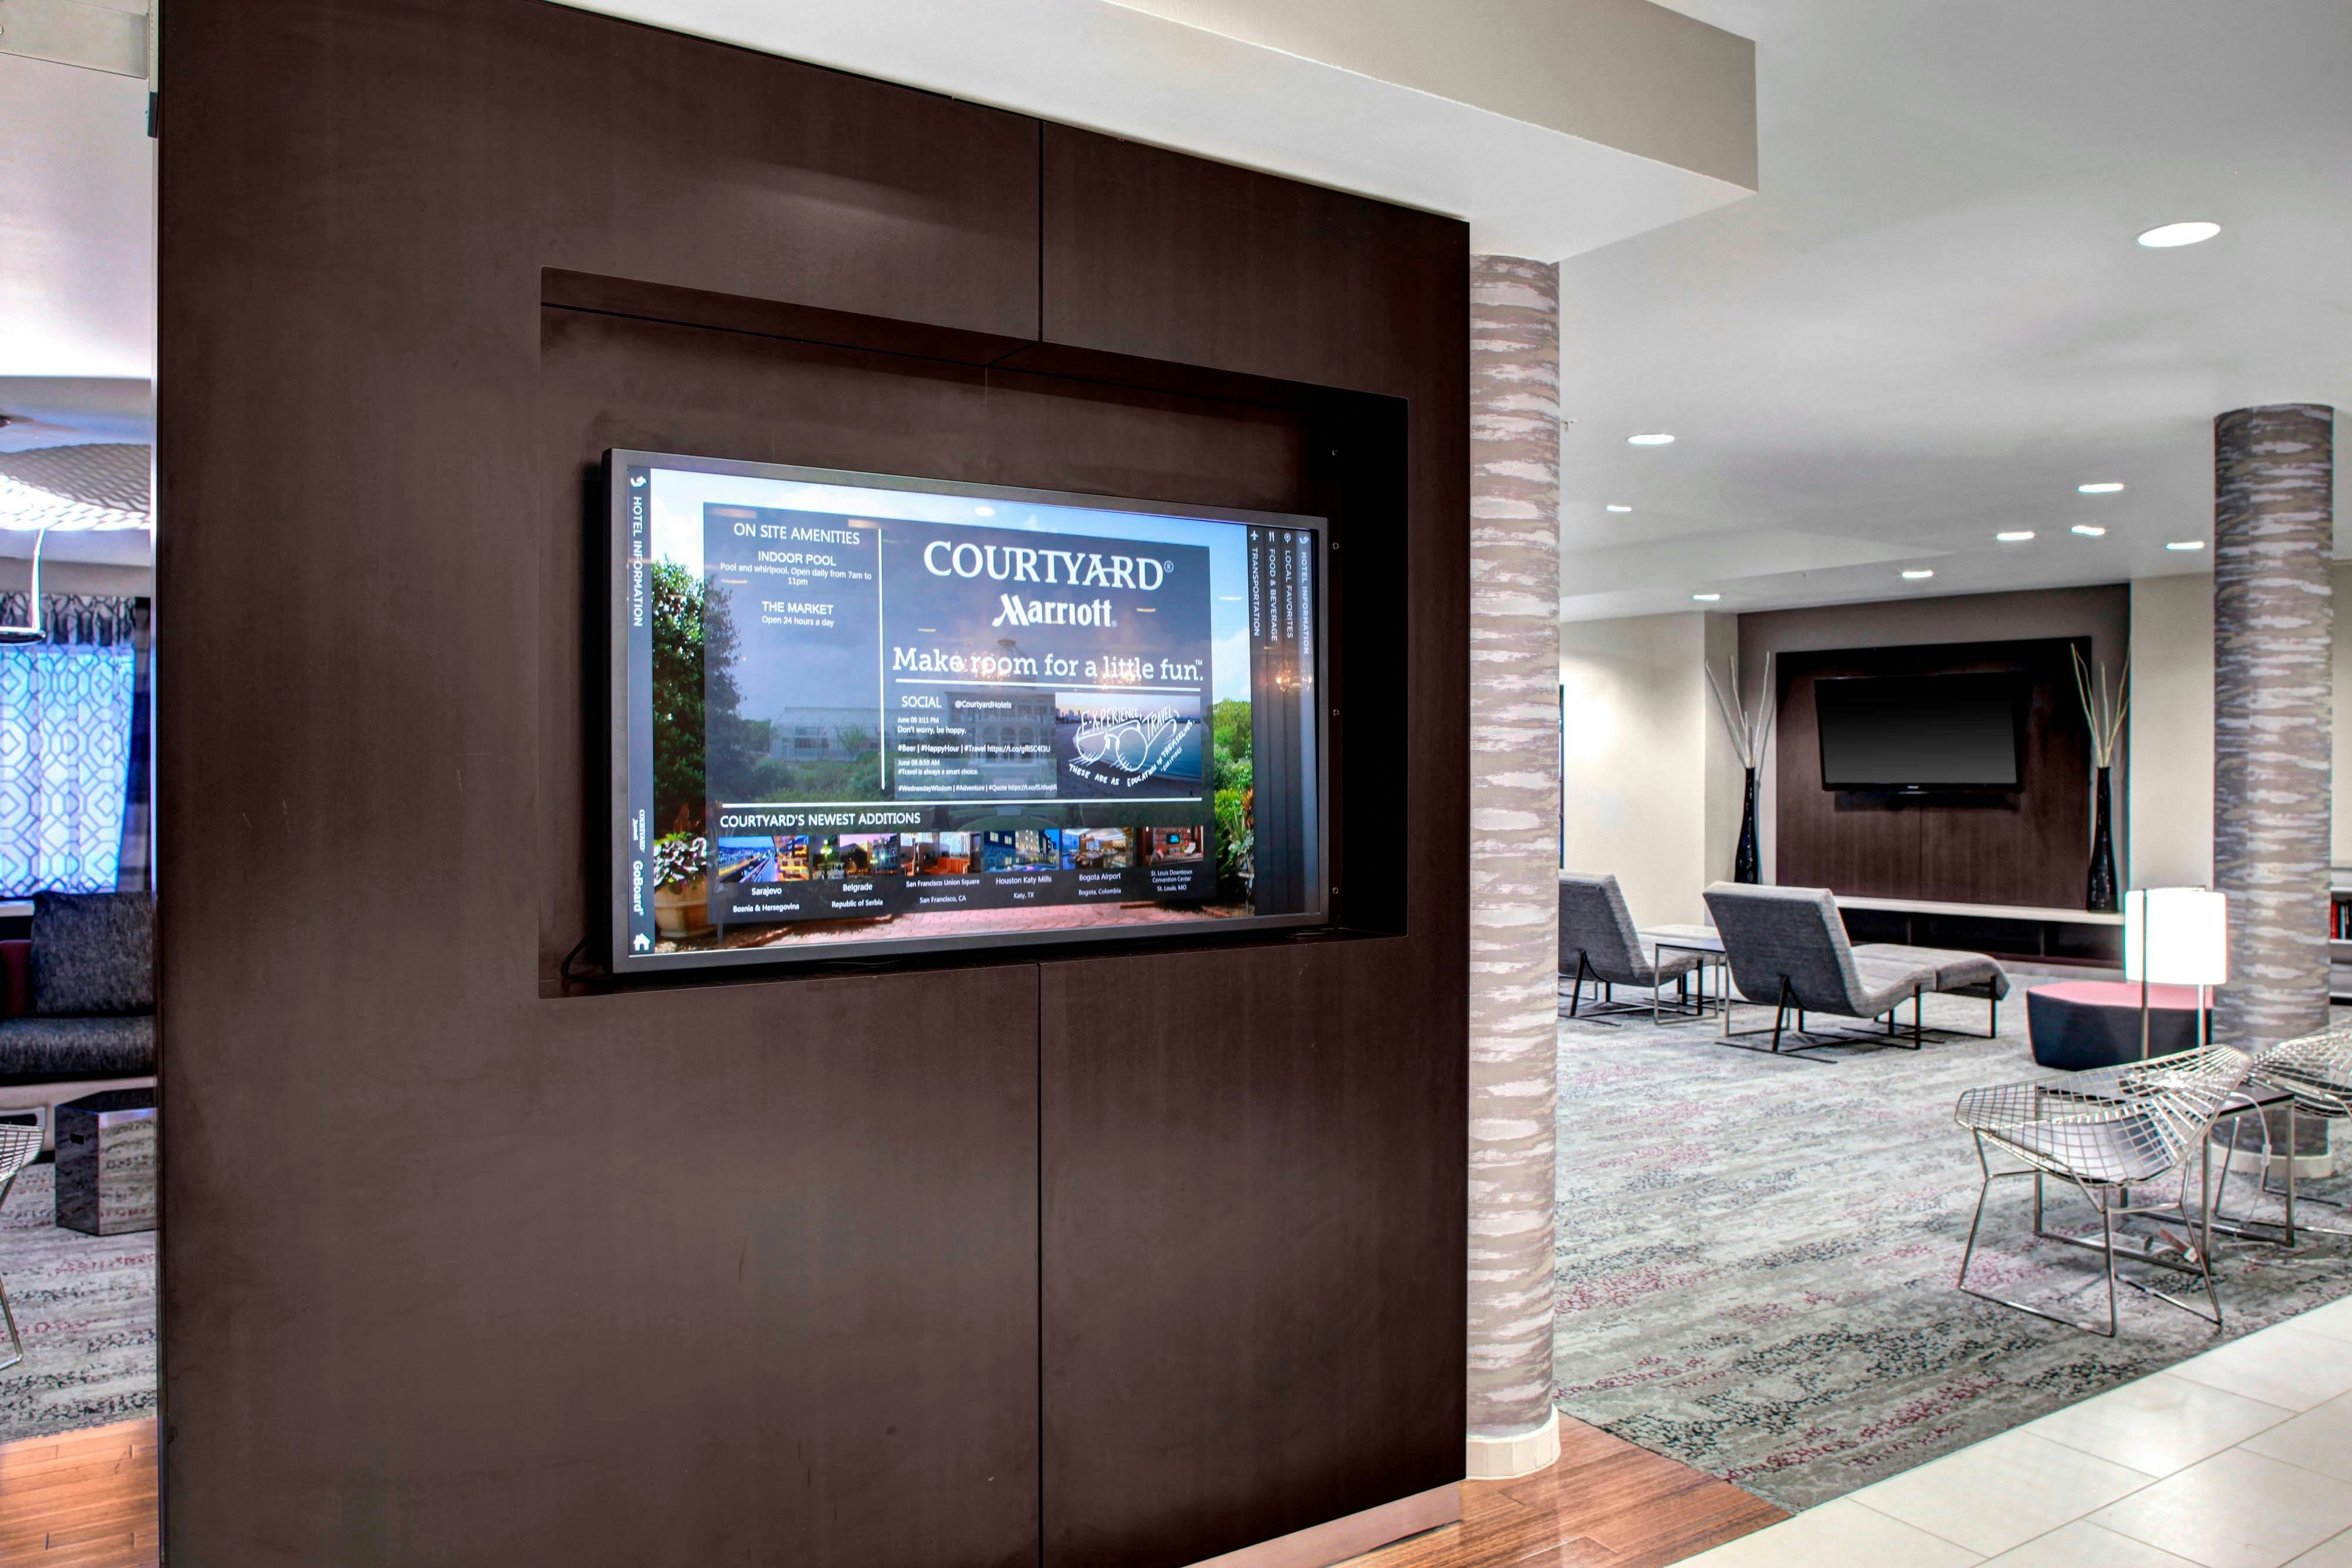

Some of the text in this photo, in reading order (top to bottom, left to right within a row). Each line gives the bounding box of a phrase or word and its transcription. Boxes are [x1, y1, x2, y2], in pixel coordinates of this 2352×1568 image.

[734, 523, 860, 545] ON SITE AMENITIES
[633, 497, 643, 627] HOTEL INFORMATION
[758, 551, 837, 566] INDOOR POOL
[720, 563, 871, 580] Pool and whirlpool. Open daily from 7am to
[788, 577, 808, 587] 11pm
[1252, 547, 1260, 636] TRANSPORTATION
[762, 601, 834, 615] THE MARKET
[762, 616, 781, 626] Open
[794, 617, 814, 626] hours
[821, 618, 834, 628] day
[893, 647, 964, 672] Make
[971, 653, 1038, 675] room
[1045, 654, 1078, 676] for
[1085, 659, 1098, 677] a
[1104, 656, 1154, 679] little
[901, 696, 941, 708] SOCIAL
[955, 700, 1011, 710] @CourtyardHotels
[916, 727, 935, 735] worry,
[921, 744, 960, 754] #HappyHour
[1068, 763, 1091, 779] THESE
[1094, 773, 1108, 784] ARE
[1111, 777, 1120, 785] AS
[1127, 764, 1157, 787] EDUCATION
[1157, 756, 1162, 765] IN
[720, 812, 921, 828] COURTYARD'S NEWEST ADDITIONS
[961, 878, 980, 887] Square
[1023, 876, 1036, 885] Katy
[1079, 872, 1121, 882] Bogota Airport
[751, 887, 782, 897] Sarajevo
[843, 882, 873, 892] Belgrade
[1078, 889, 1097, 897] Bogota,
[831, 900, 857, 909] Republic
[866, 898, 883, 906] Serbia
[931, 895, 957, 904] Francisco,
